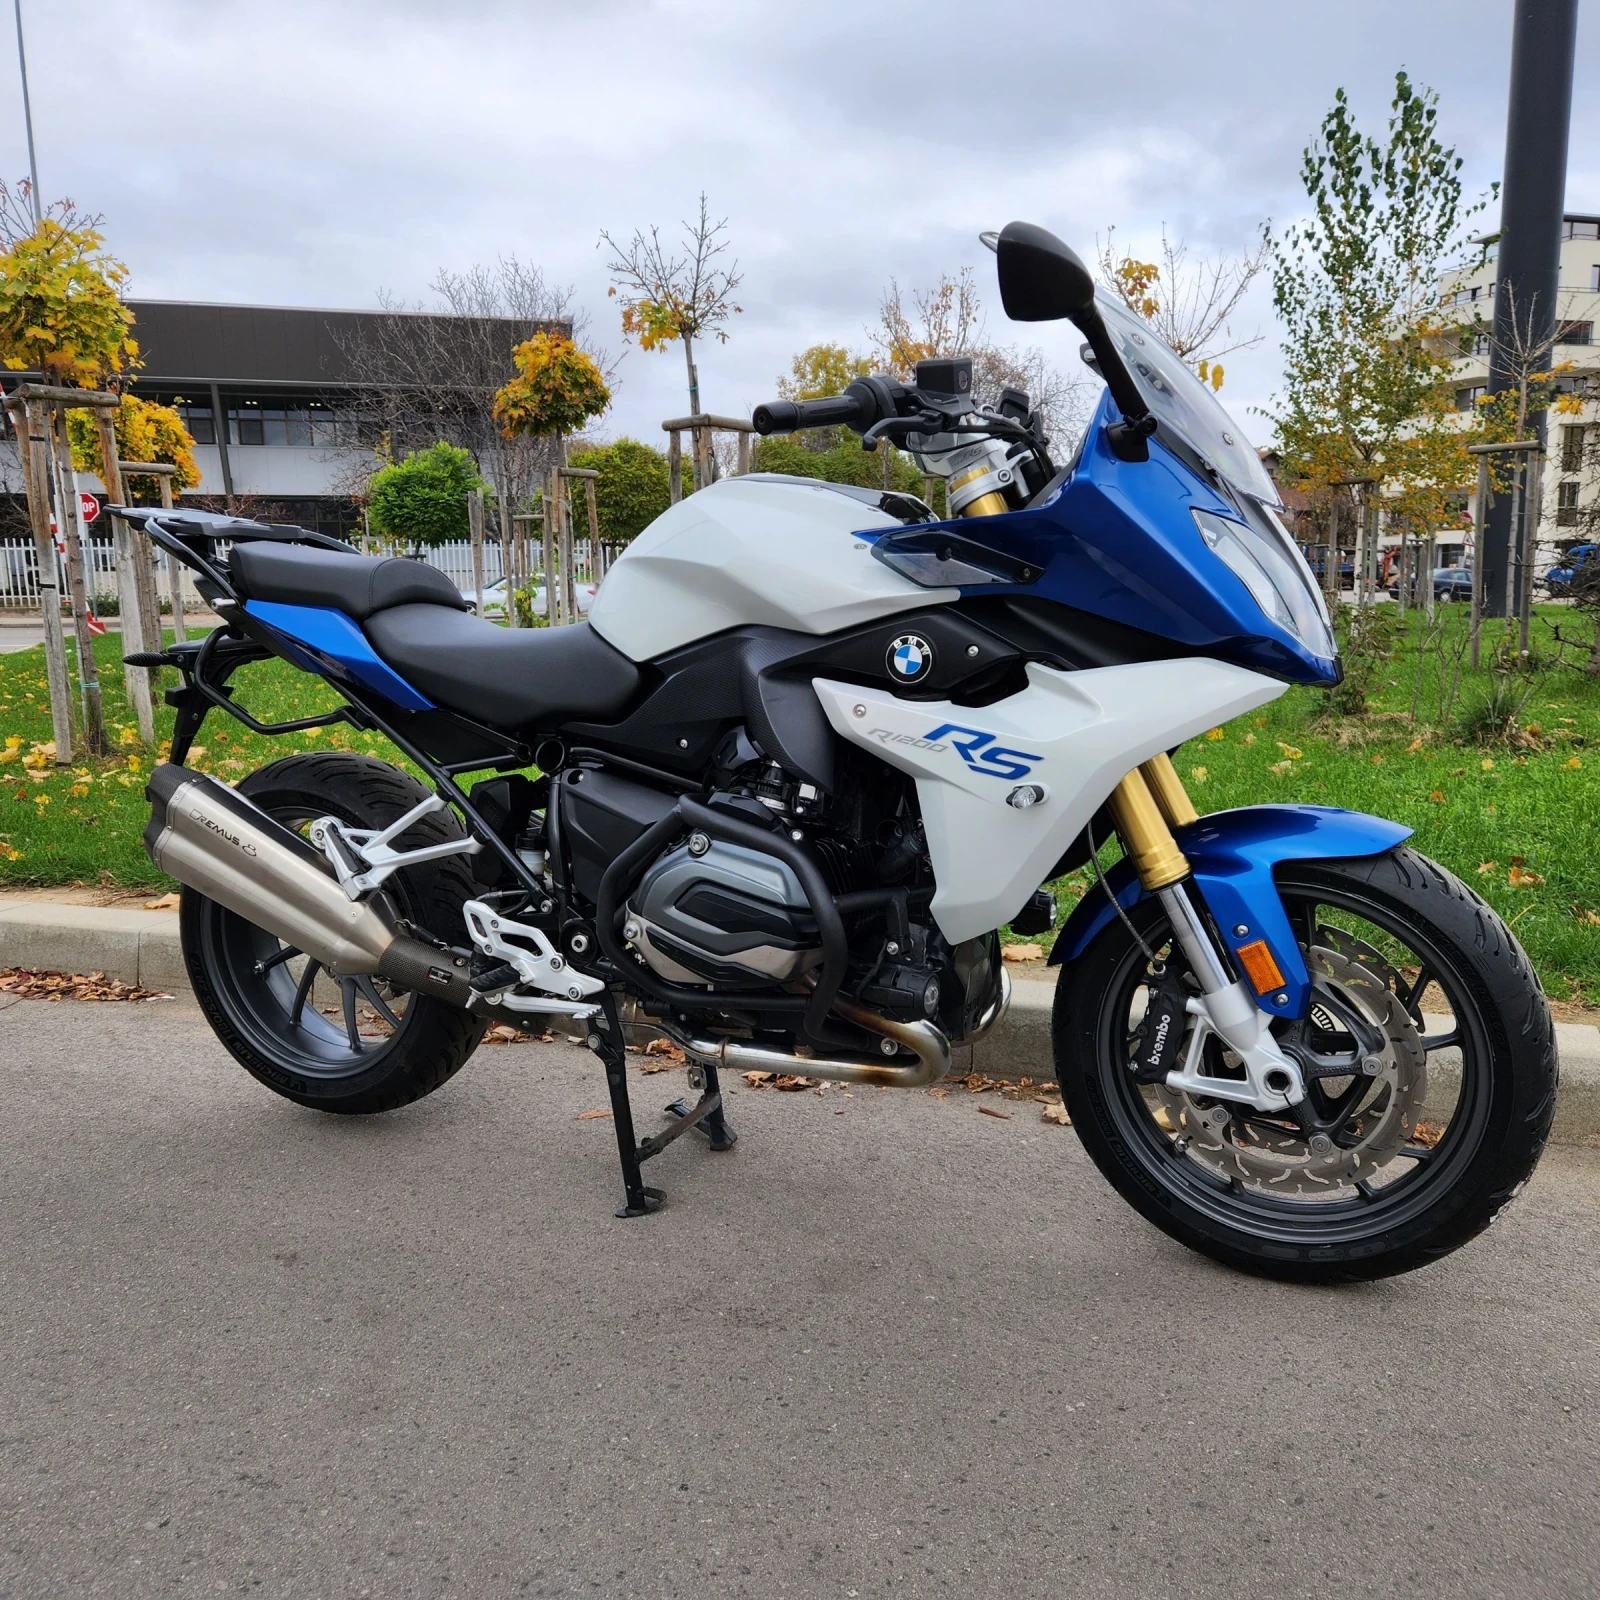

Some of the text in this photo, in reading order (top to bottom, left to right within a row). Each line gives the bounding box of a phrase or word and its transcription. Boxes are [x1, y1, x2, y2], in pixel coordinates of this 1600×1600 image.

[893, 637, 930, 656] BMW
[868, 723, 1044, 780] R1200 RS
[189, 808, 241, 847] REMUS
[233, 1040, 289, 1085] MICHELIN
[1147, 1014, 1171, 1066] brembo
[1113, 1143, 1158, 1193] MICHELIN
